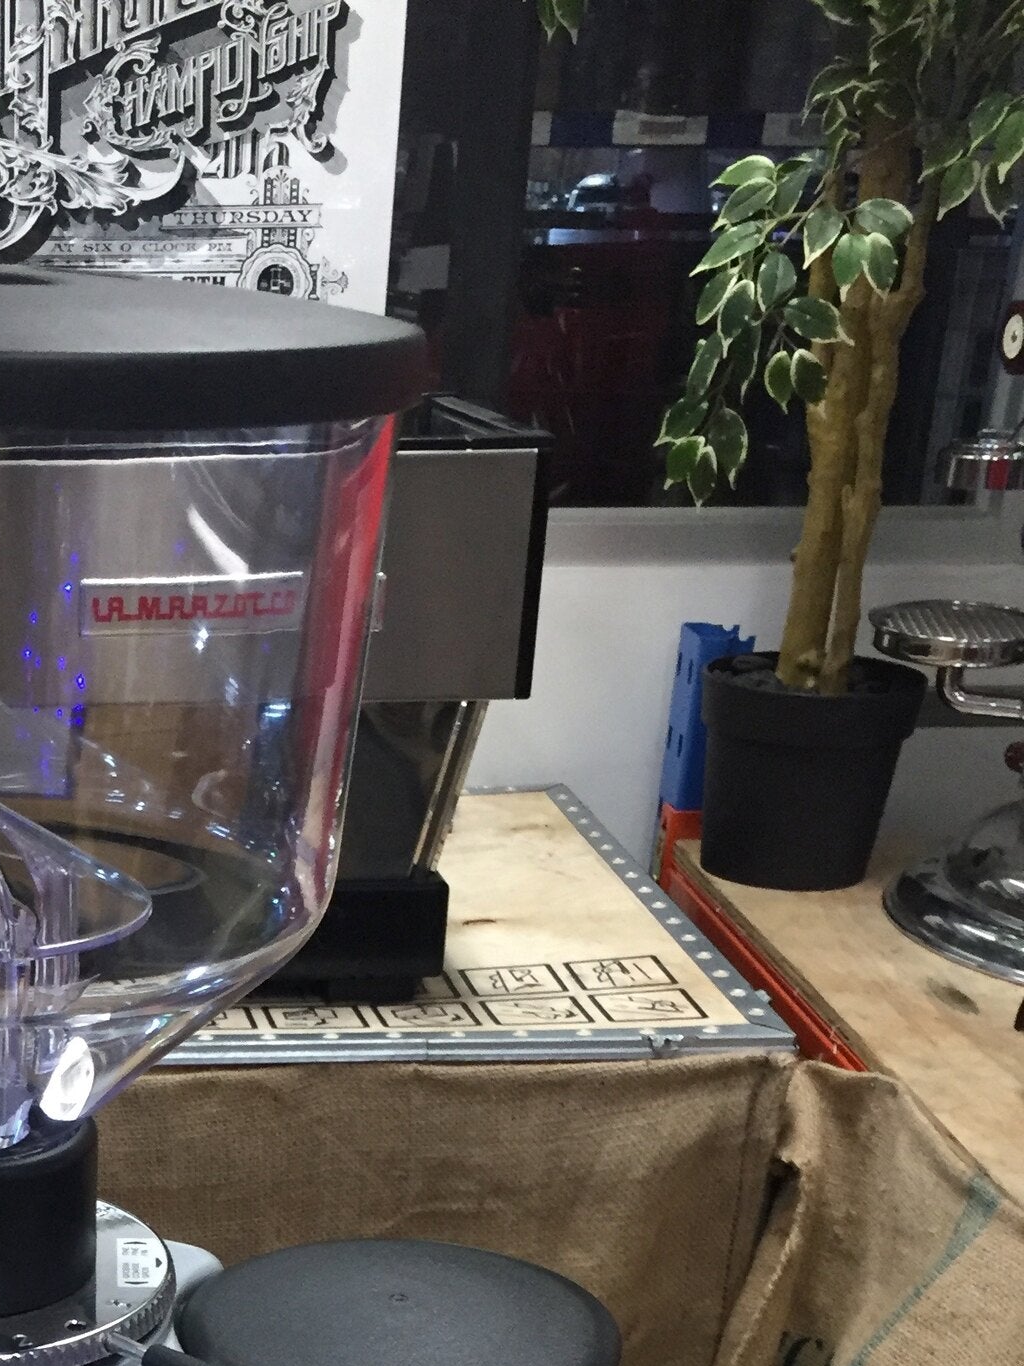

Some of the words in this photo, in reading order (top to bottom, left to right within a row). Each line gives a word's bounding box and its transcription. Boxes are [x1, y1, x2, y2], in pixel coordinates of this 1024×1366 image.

[173, 208, 314, 226] THURSDAY
[52, 242, 75, 253] AT
[83, 242, 112, 253] SIX
[207, 241, 233, 253] PM
